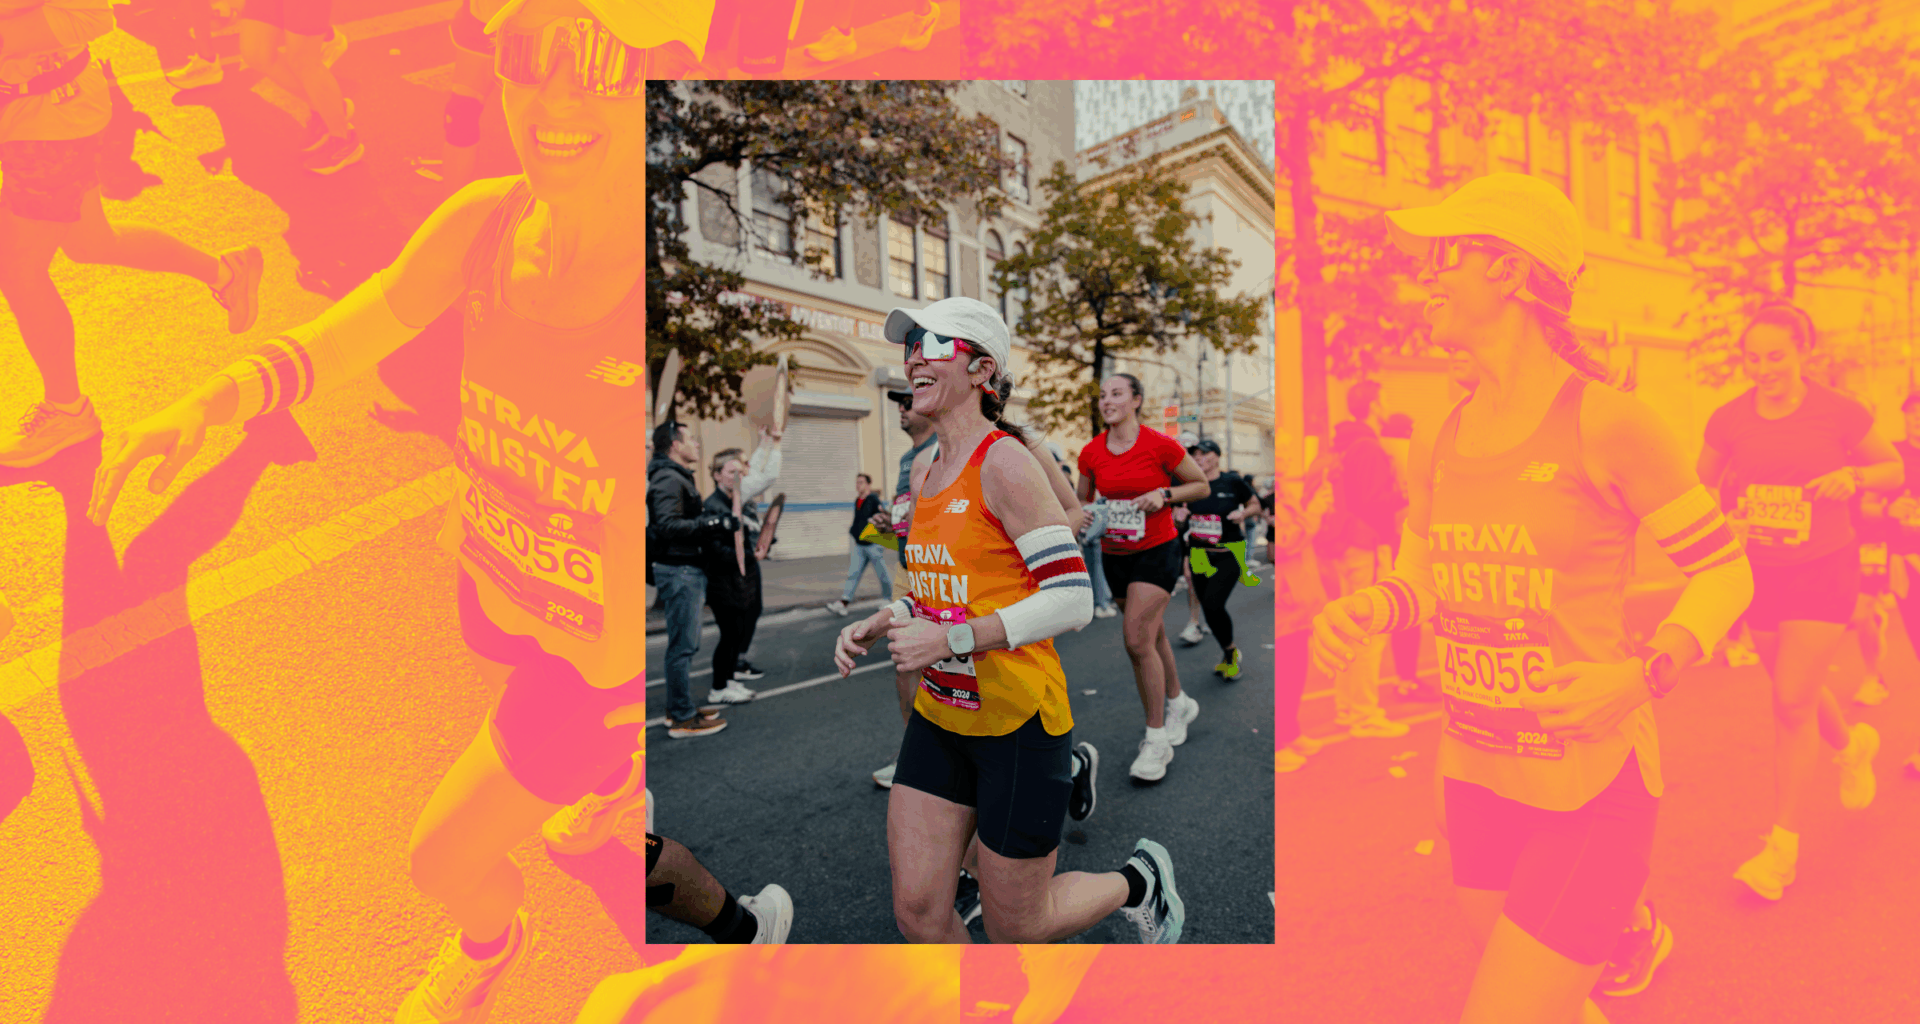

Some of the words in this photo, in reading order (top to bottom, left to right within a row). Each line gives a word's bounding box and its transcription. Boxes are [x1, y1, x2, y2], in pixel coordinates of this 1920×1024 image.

[742, 55, 777, 65] SPALDING
[1107, 511, 1142, 525] 3225
[465, 483, 595, 585] 45056
[545, 526, 577, 541] TATA
[486, 533, 502, 548] PINK
[501, 545, 524, 568] CORRAL
[904, 543, 956, 566] TRAVA
[547, 601, 584, 626] 2024
[1455, 616, 1471, 625] TATA
[1503, 632, 1529, 641] TATA
[1444, 642, 1549, 694] 45056
[952, 688, 970, 699] 2024
[1494, 695, 1502, 705] B
[1517, 731, 1548, 745] 2024
